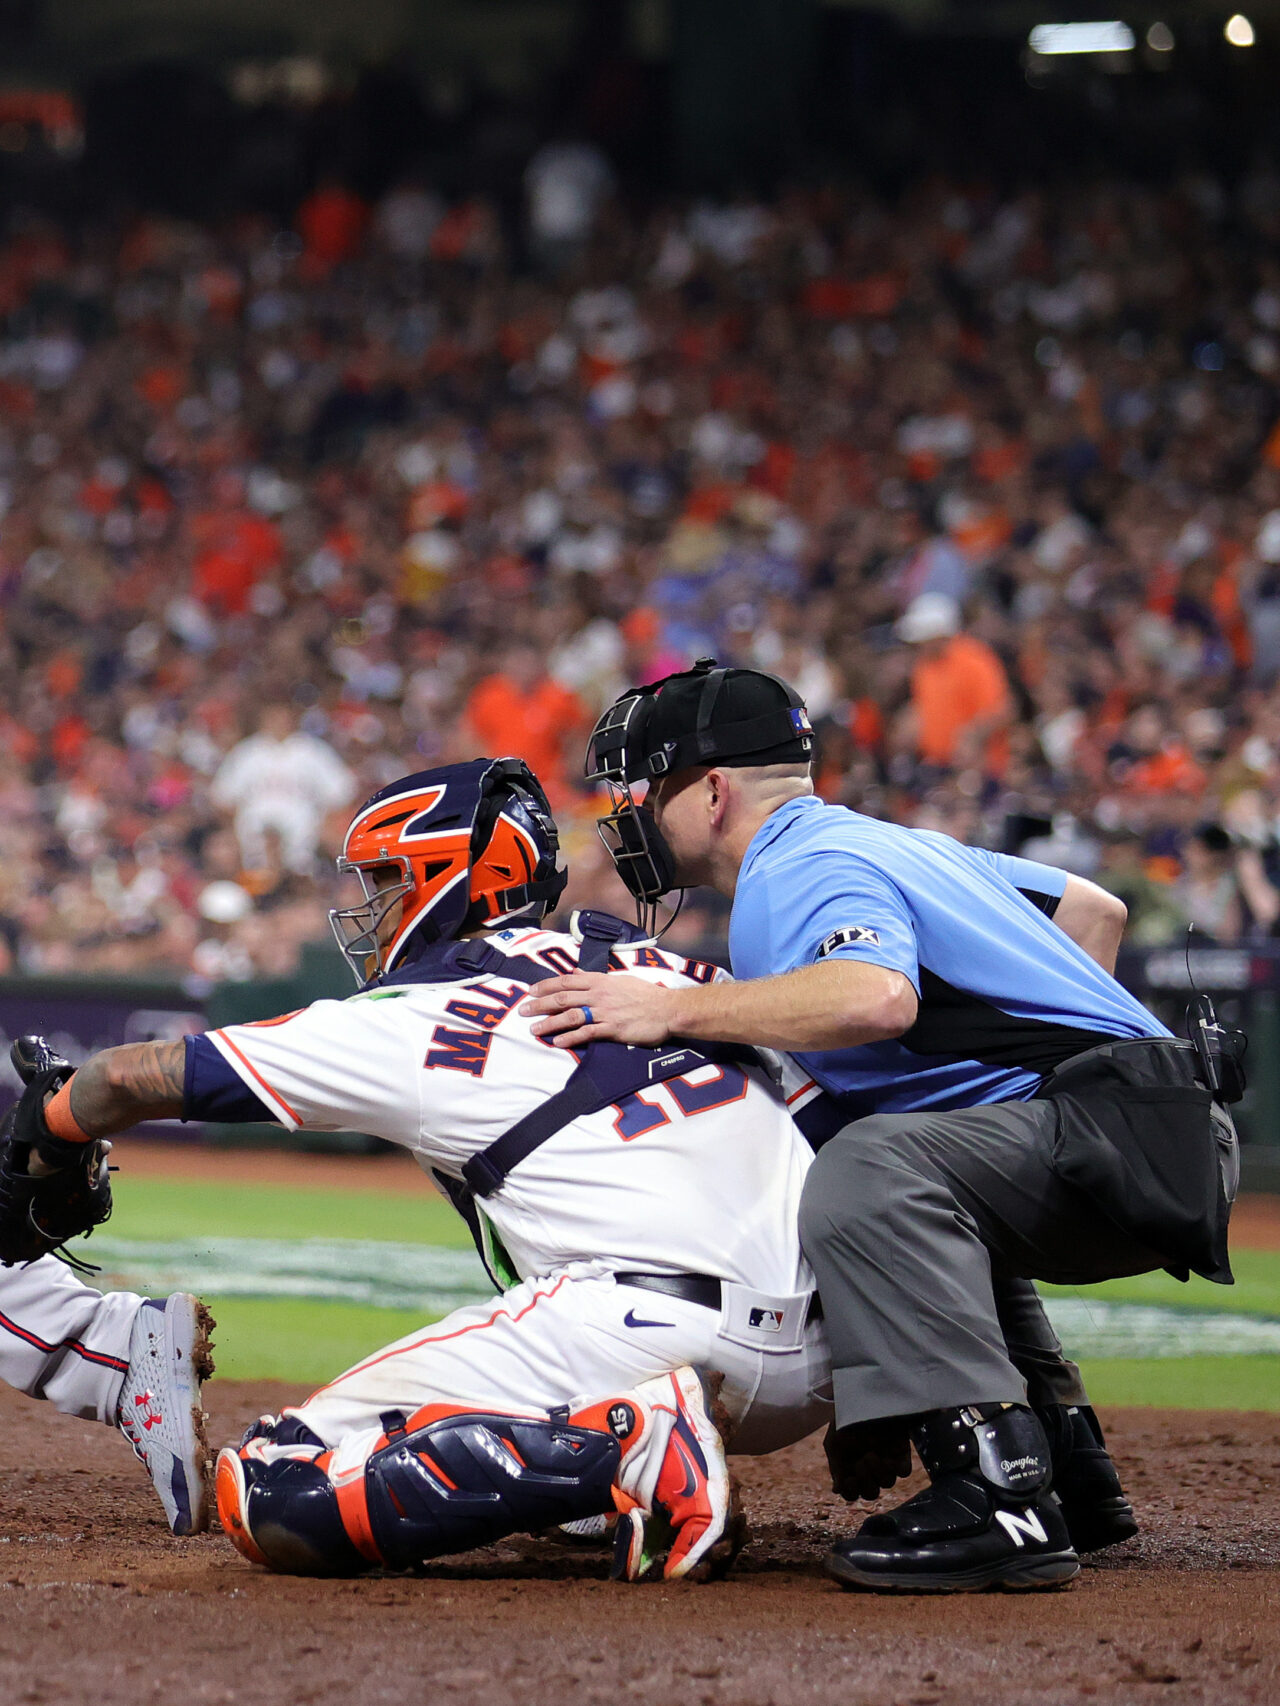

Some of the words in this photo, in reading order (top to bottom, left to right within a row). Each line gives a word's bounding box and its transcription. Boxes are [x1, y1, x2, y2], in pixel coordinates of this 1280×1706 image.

[822, 926, 879, 956] FTX
[610, 1407, 629, 1435] 15
[1000, 1455, 1039, 1473] Douglas
